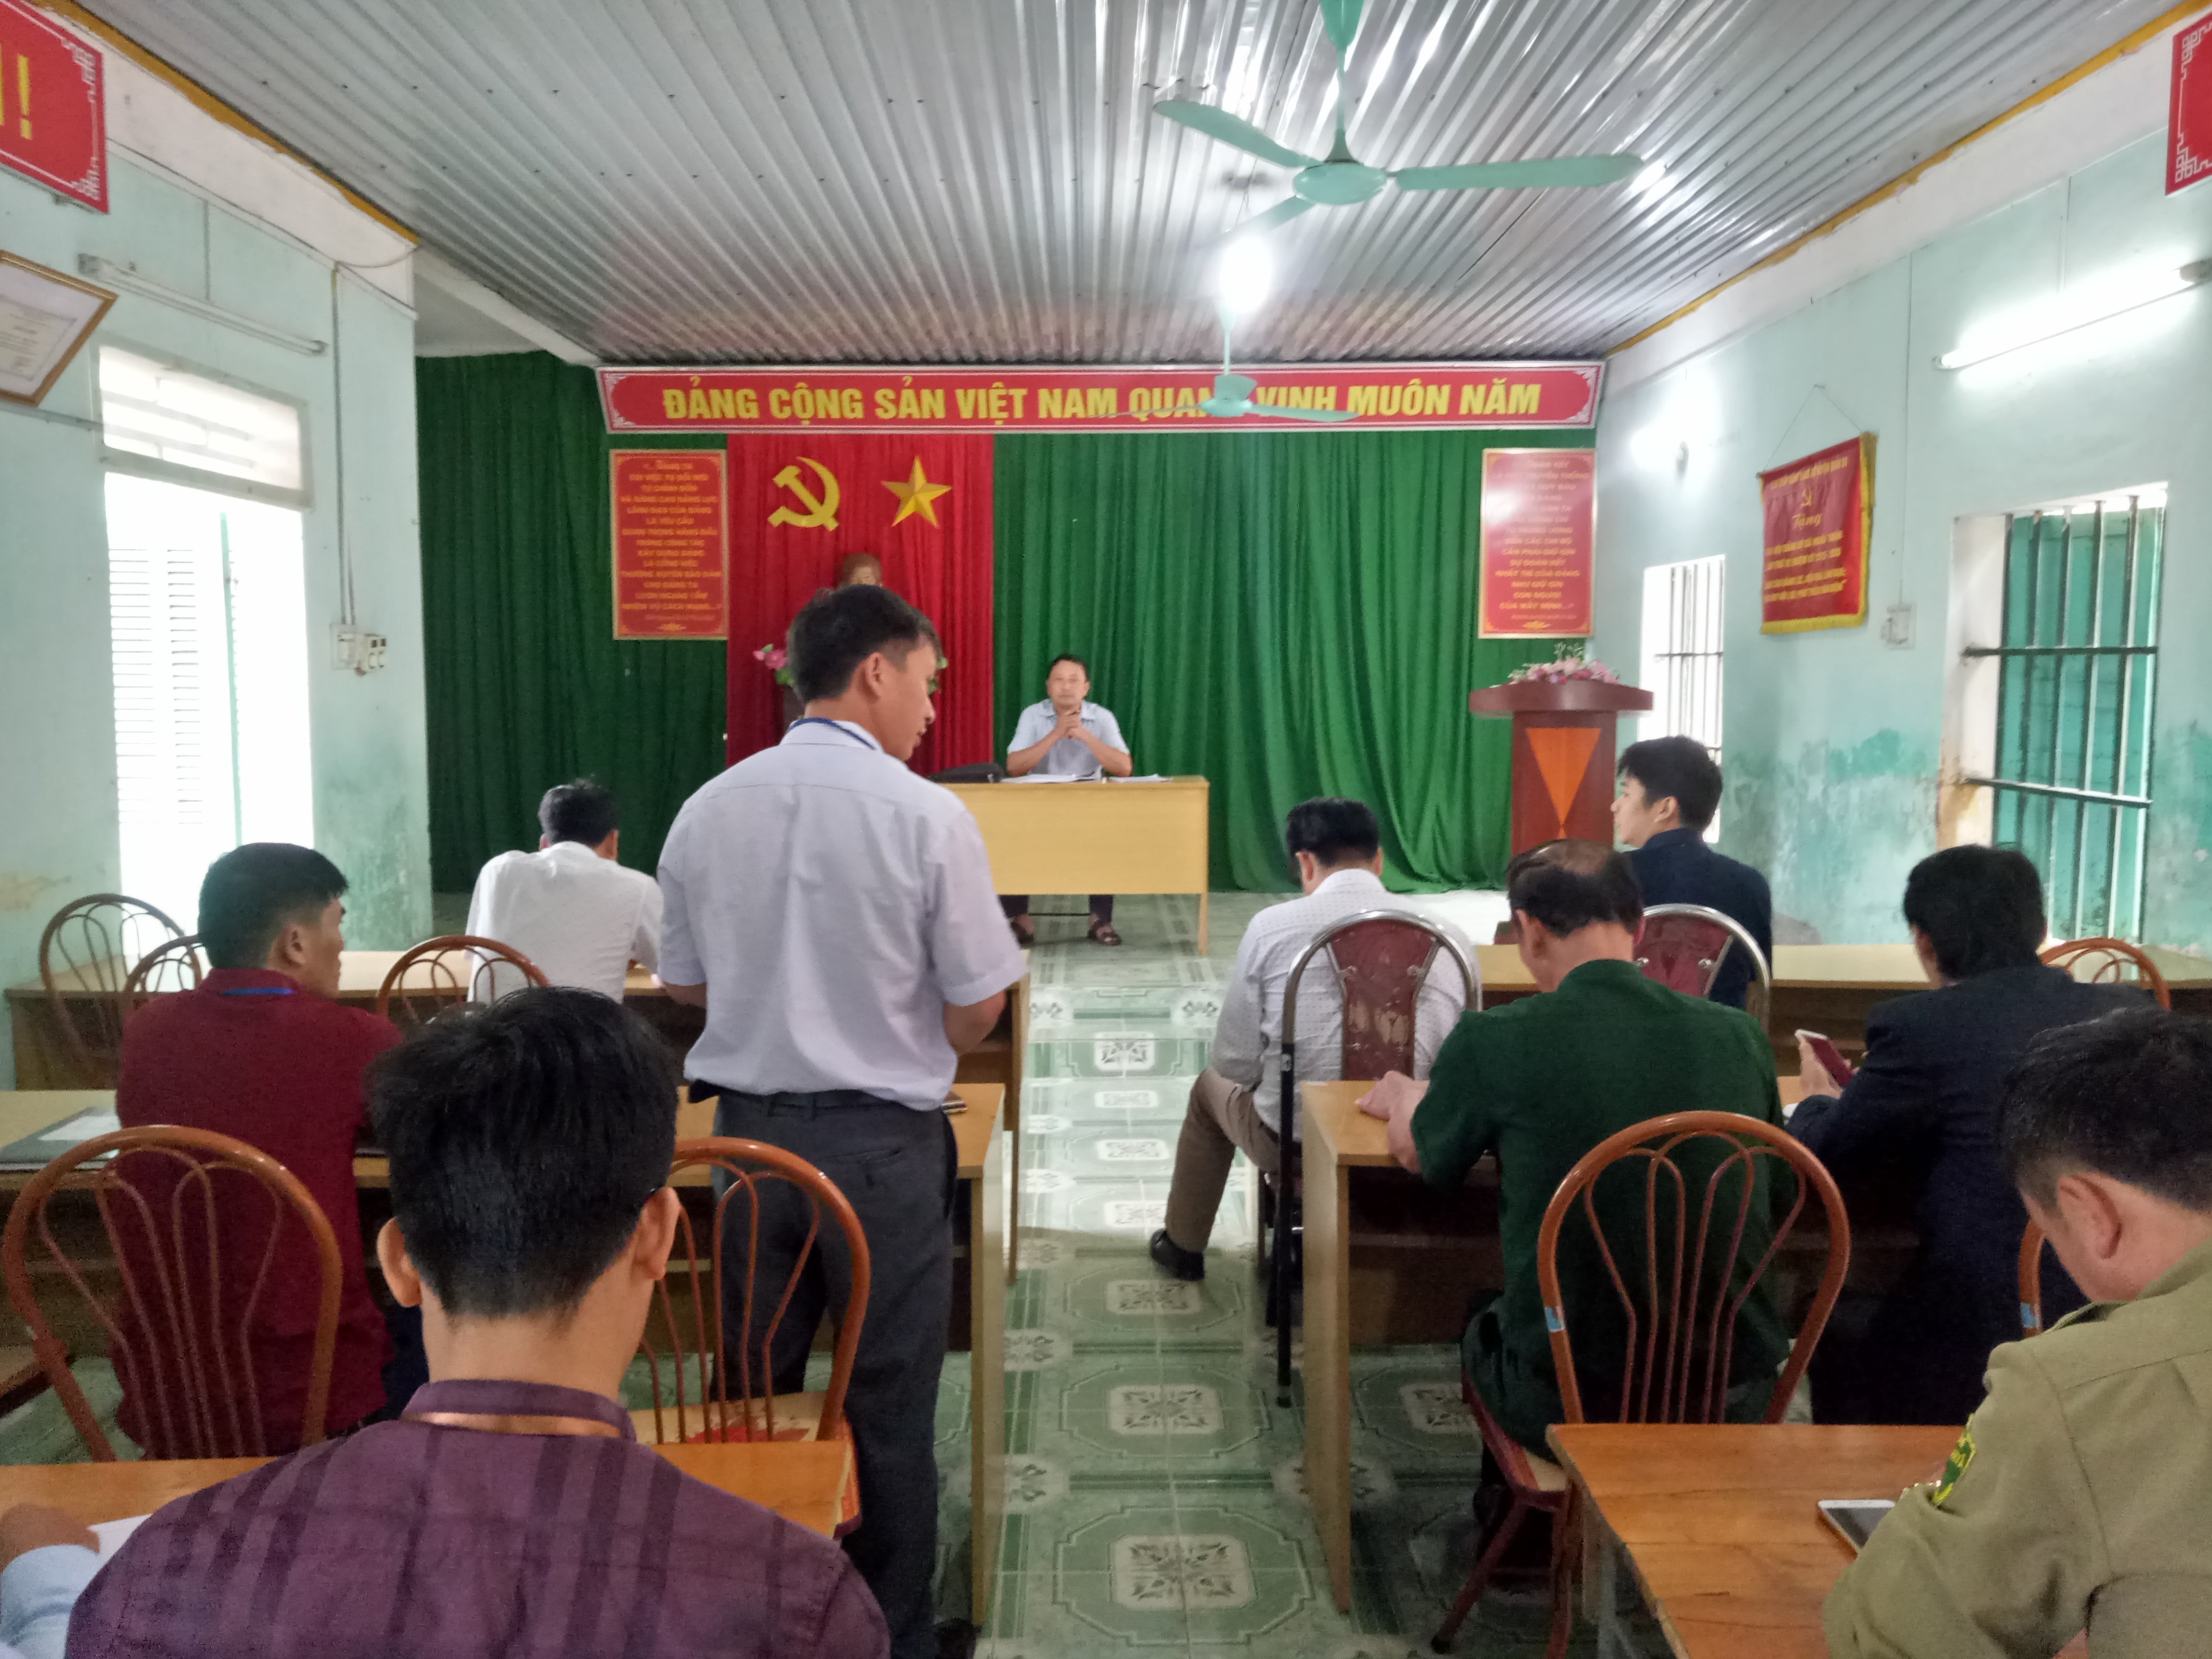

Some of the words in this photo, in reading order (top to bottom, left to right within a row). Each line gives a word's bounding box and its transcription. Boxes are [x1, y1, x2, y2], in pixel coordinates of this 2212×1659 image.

[663, 375, 759, 418] ĐẢNG
[769, 382, 864, 425] CỘNG
[874, 375, 945, 419] SẢN
[956, 382, 1027, 425] VIỆT
[1038, 388, 1117, 418] NAM
[1128, 387, 1244, 422] QUA
[1347, 378, 1451, 416] MUÔN
[1459, 378, 1541, 415] NĂM
